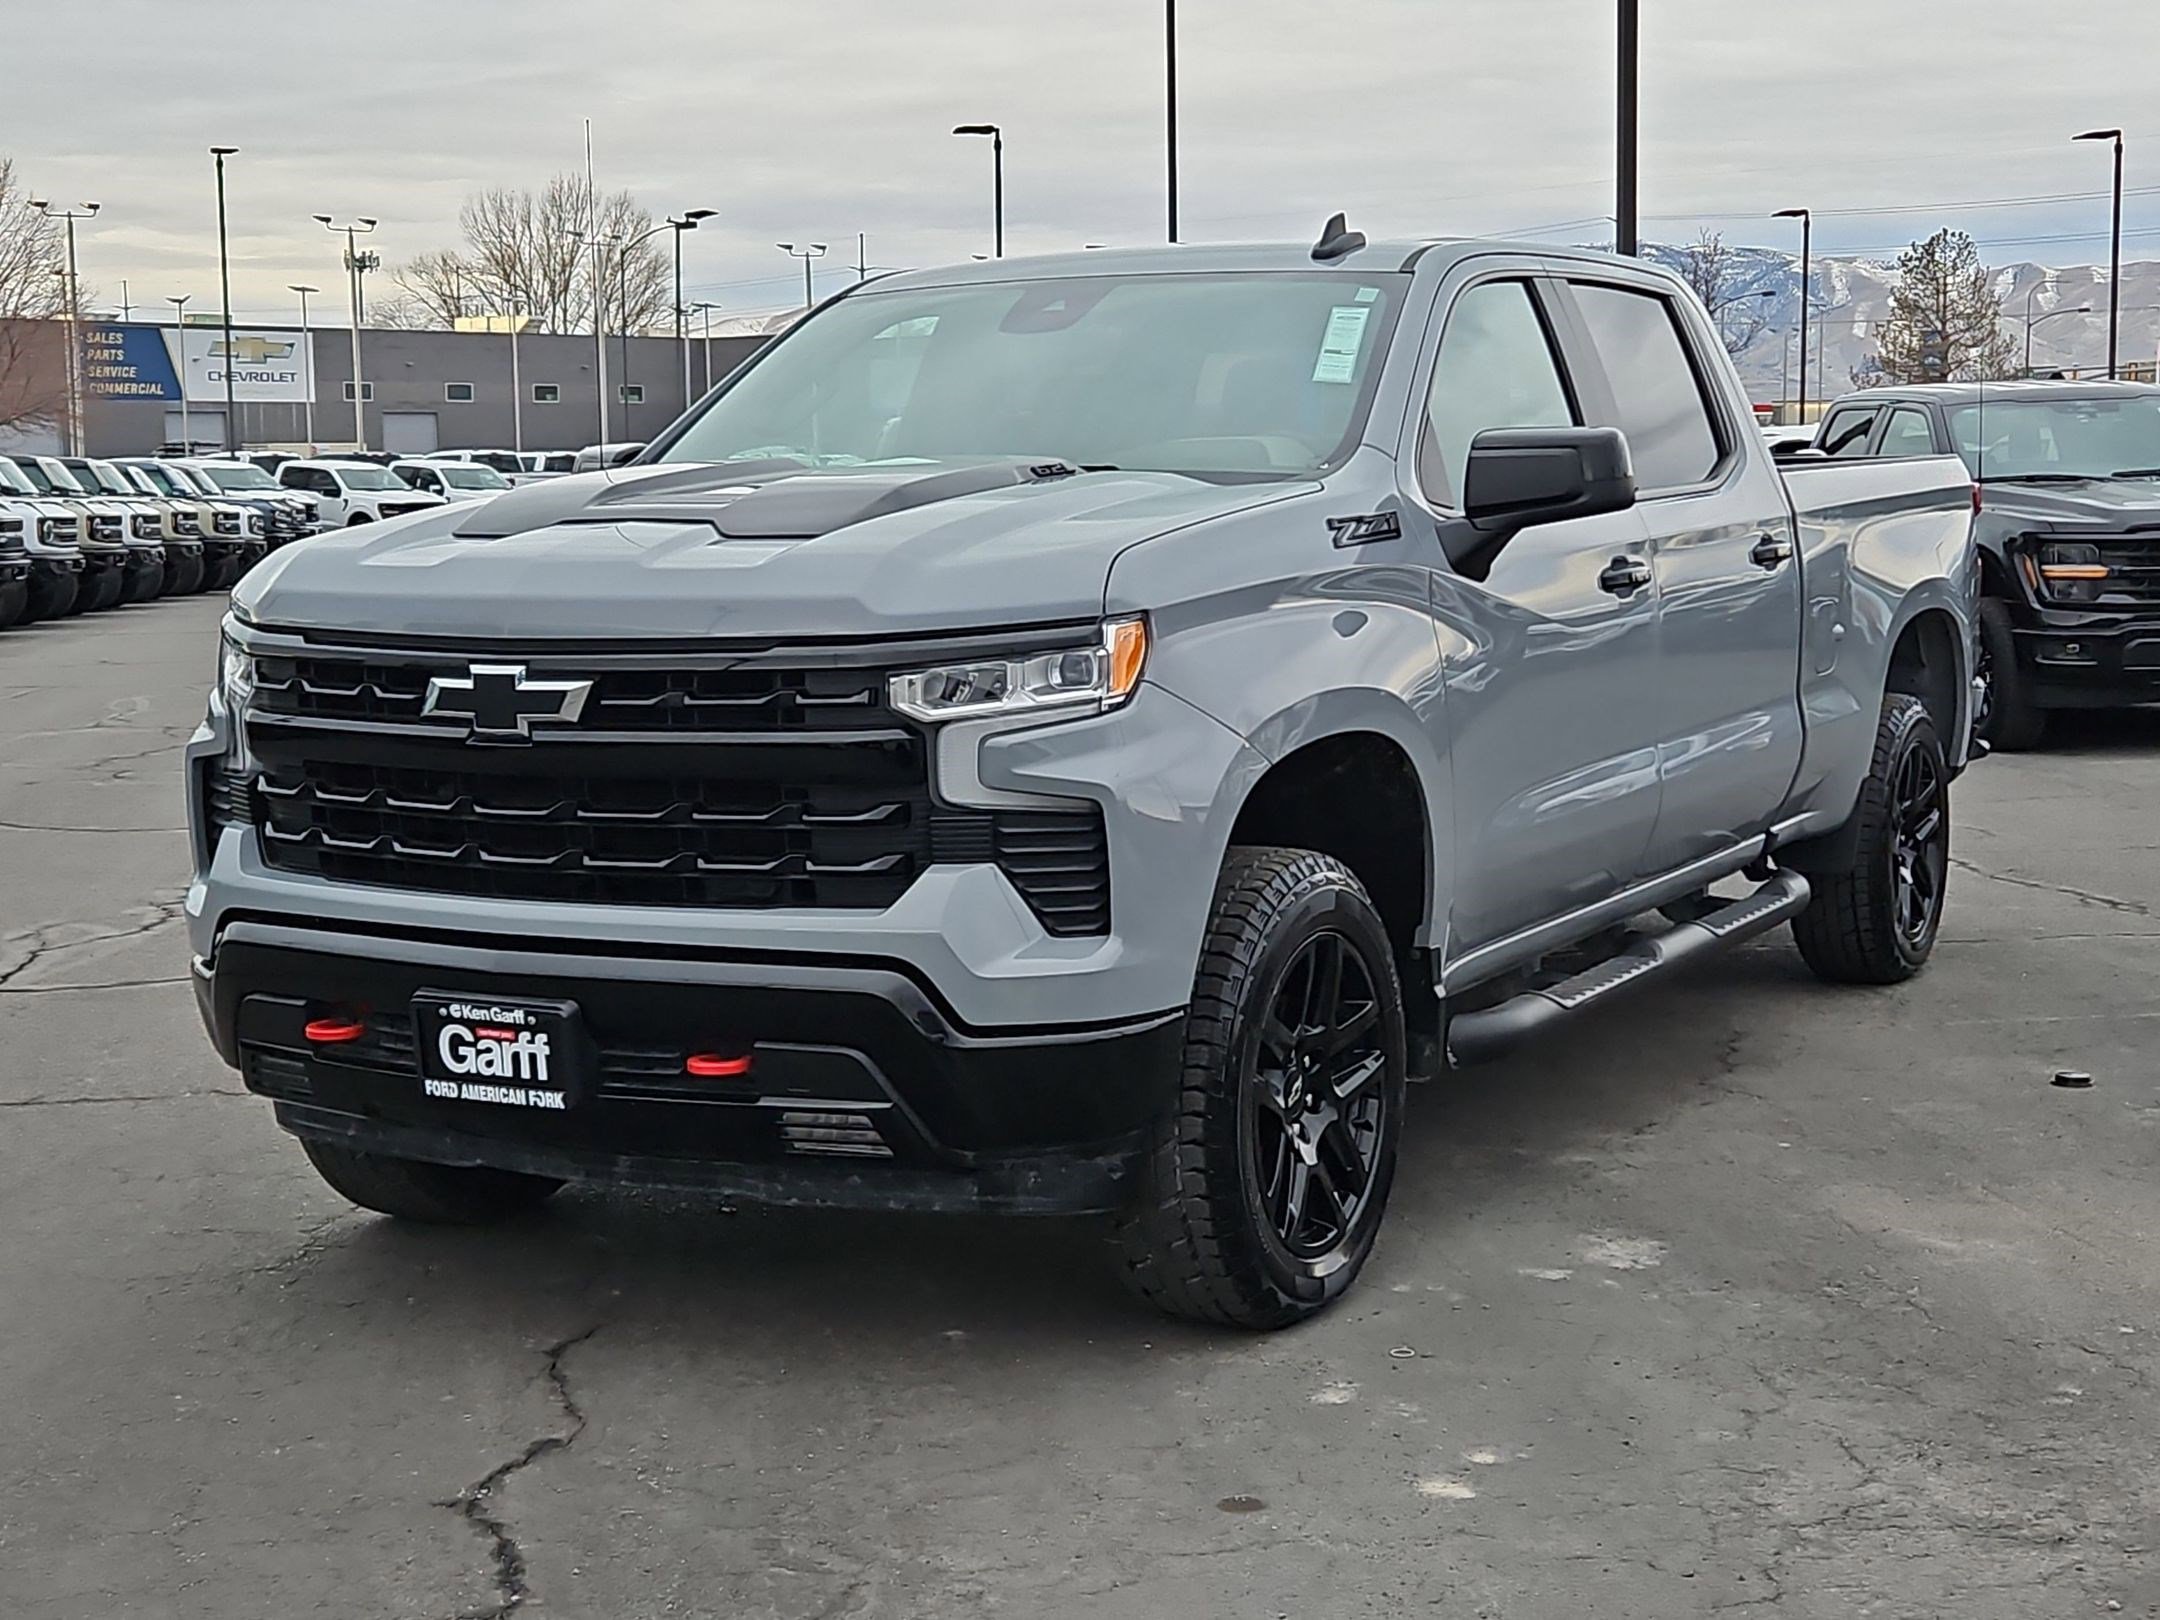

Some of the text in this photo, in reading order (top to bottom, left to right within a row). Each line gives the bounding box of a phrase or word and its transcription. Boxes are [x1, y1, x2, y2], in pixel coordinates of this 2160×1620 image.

[86, 332, 124, 344] SALES
[87, 349, 125, 361] PARTS
[88, 366, 137, 378] SERVICE
[207, 371, 298, 382] CHEVROLET
[90, 383, 164, 395] COMMERCIAL
[462, 1004, 525, 1025] Ken Garff
[439, 1023, 550, 1081] Garff
[424, 1079, 567, 1109] FORD AMERICAN FORK
